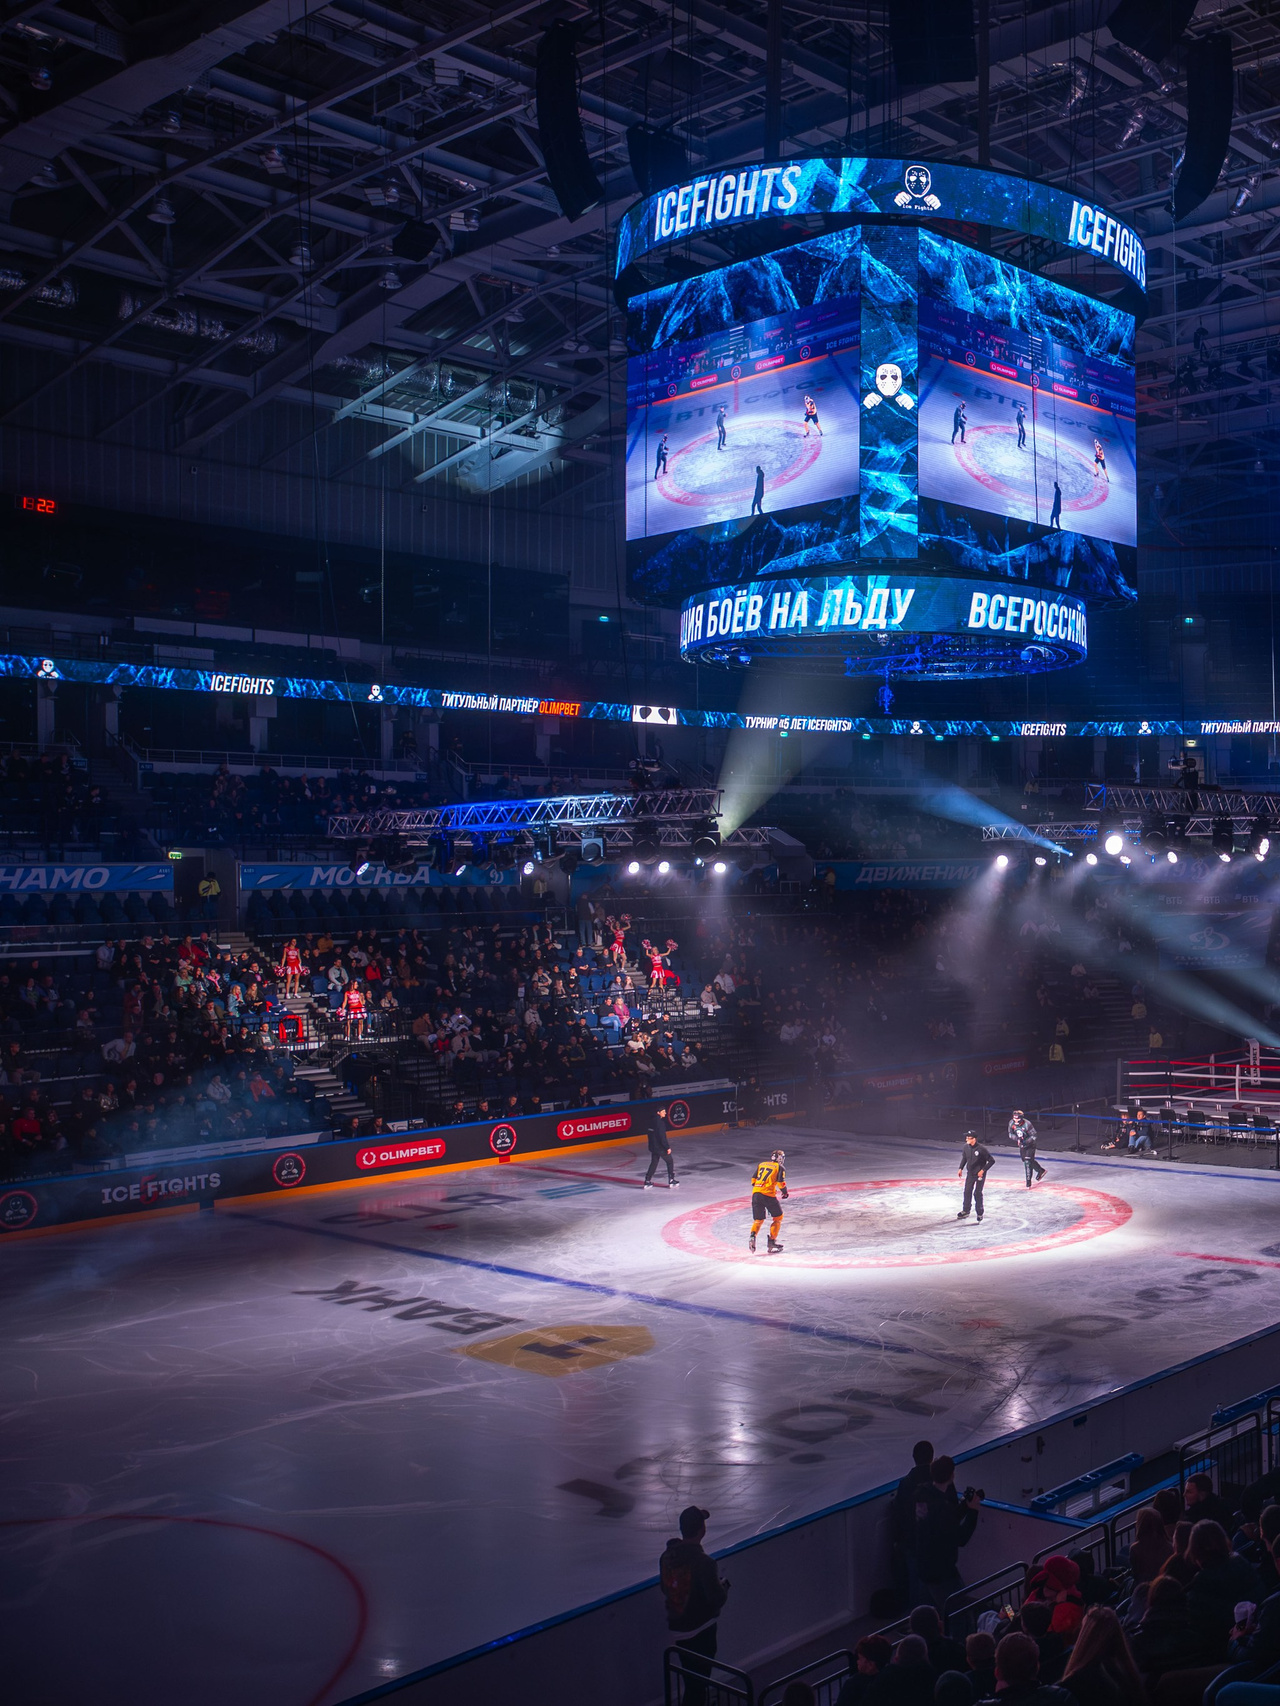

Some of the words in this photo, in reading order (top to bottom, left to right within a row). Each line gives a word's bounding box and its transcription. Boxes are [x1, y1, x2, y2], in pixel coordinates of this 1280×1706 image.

[654, 166, 802, 241] ICEFIGHTS
[1068, 200, 1147, 287] ICEFIGHTS
[707, 589, 762, 638] БОЁВ
[770, 591, 808, 634] НА
[816, 588, 915, 633] ЛЬДУ
[211, 675, 275, 695] ICEFIGHTS
[441, 693, 498, 710] ТИТУЛЬНЫЙ
[499, 698, 539, 713] ПАРТНЁР
[539, 700, 581, 716] OLIMPBET
[745, 716, 778, 729] ТУРНИР
[790, 719, 807, 731] ЛЕТ
[1021, 723, 1067, 736] ICEFIGHTS
[1200, 720, 1252, 734] ТИТУЛЬНЫЙ
[855, 865, 980, 885] ДВИЖЕНИИ
[576, 1118, 628, 1133] OLIMPBET
[379, 1144, 442, 1162] OLIMPBET
[757, 1167, 773, 1182] 37
[101, 1183, 140, 1205] ICE
[147, 1172, 221, 1198] FIGHTS
[291, 1279, 525, 1335] БАНК
